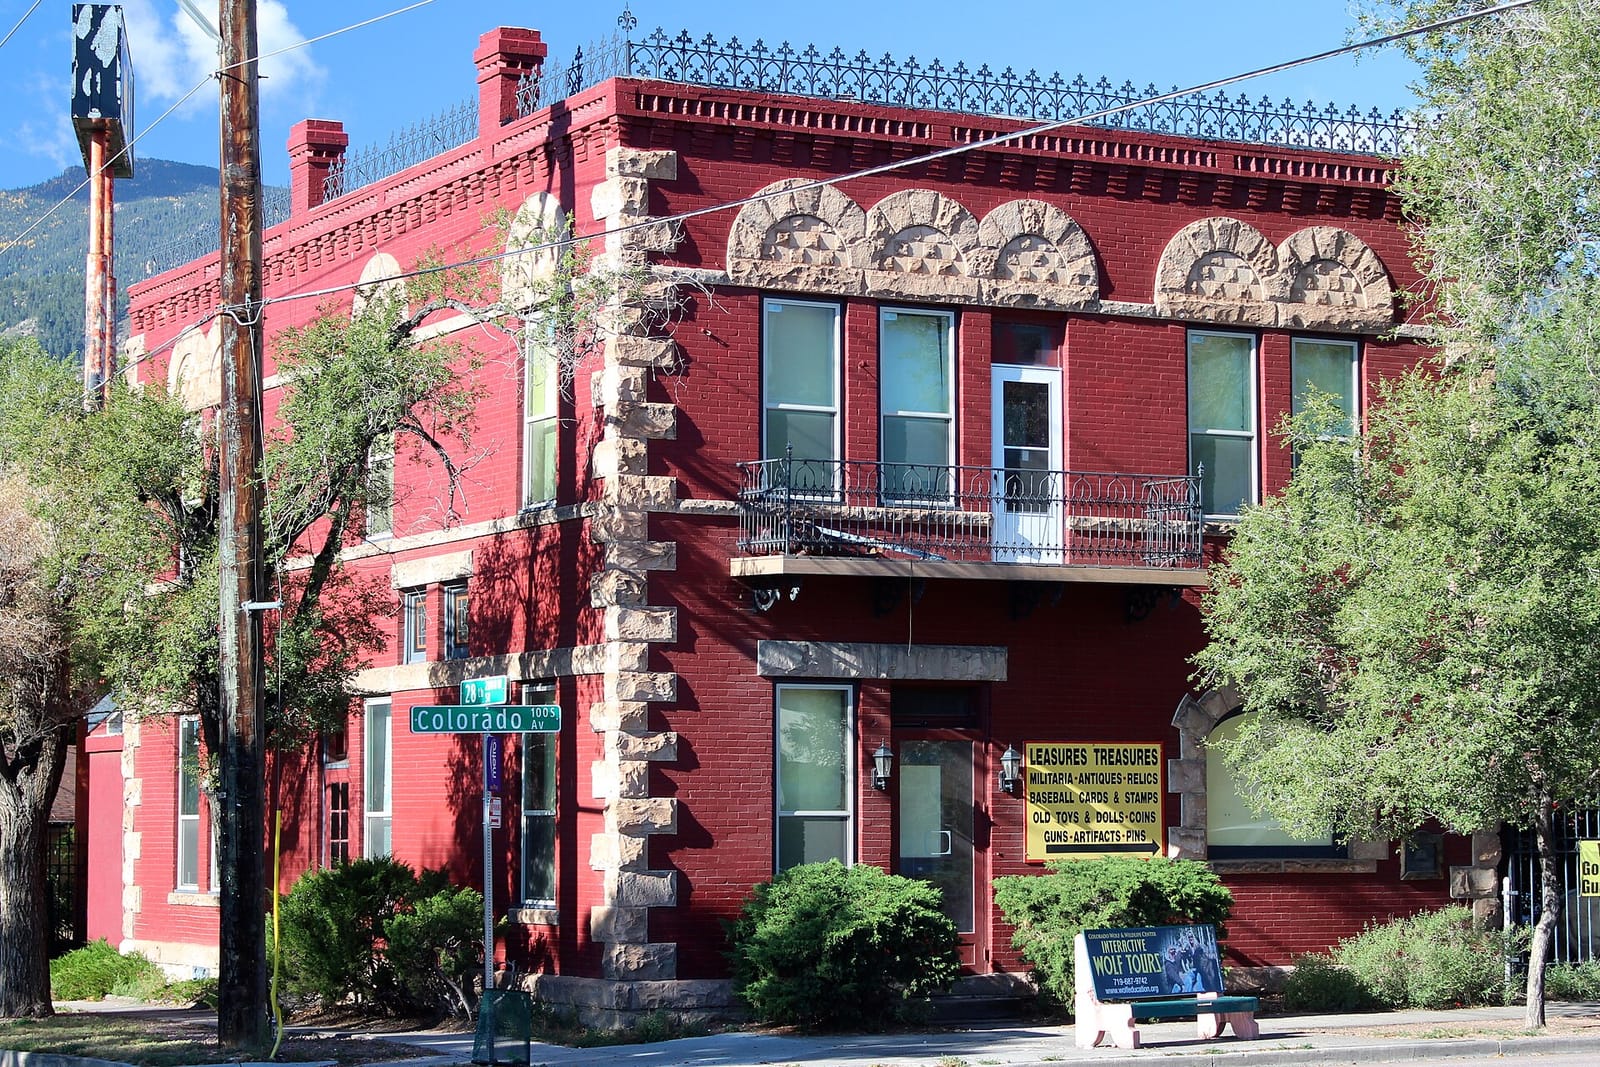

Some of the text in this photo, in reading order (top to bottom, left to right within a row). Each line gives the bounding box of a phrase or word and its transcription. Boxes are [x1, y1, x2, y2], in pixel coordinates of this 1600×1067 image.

[417, 708, 522, 730] Colorado
[1029, 748, 1158, 766] LEASURES TREASURES
[1029, 791, 1158, 804] BASEBALL CARDS & STAMPS
[1033, 811, 1051, 824] OLD
[1056, 811, 1079, 823] TOYS
[1084, 811, 1091, 823] &
[1101, 939, 1147, 954] INTERACTIVE
[1092, 953, 1162, 976] WOLF TOURS
